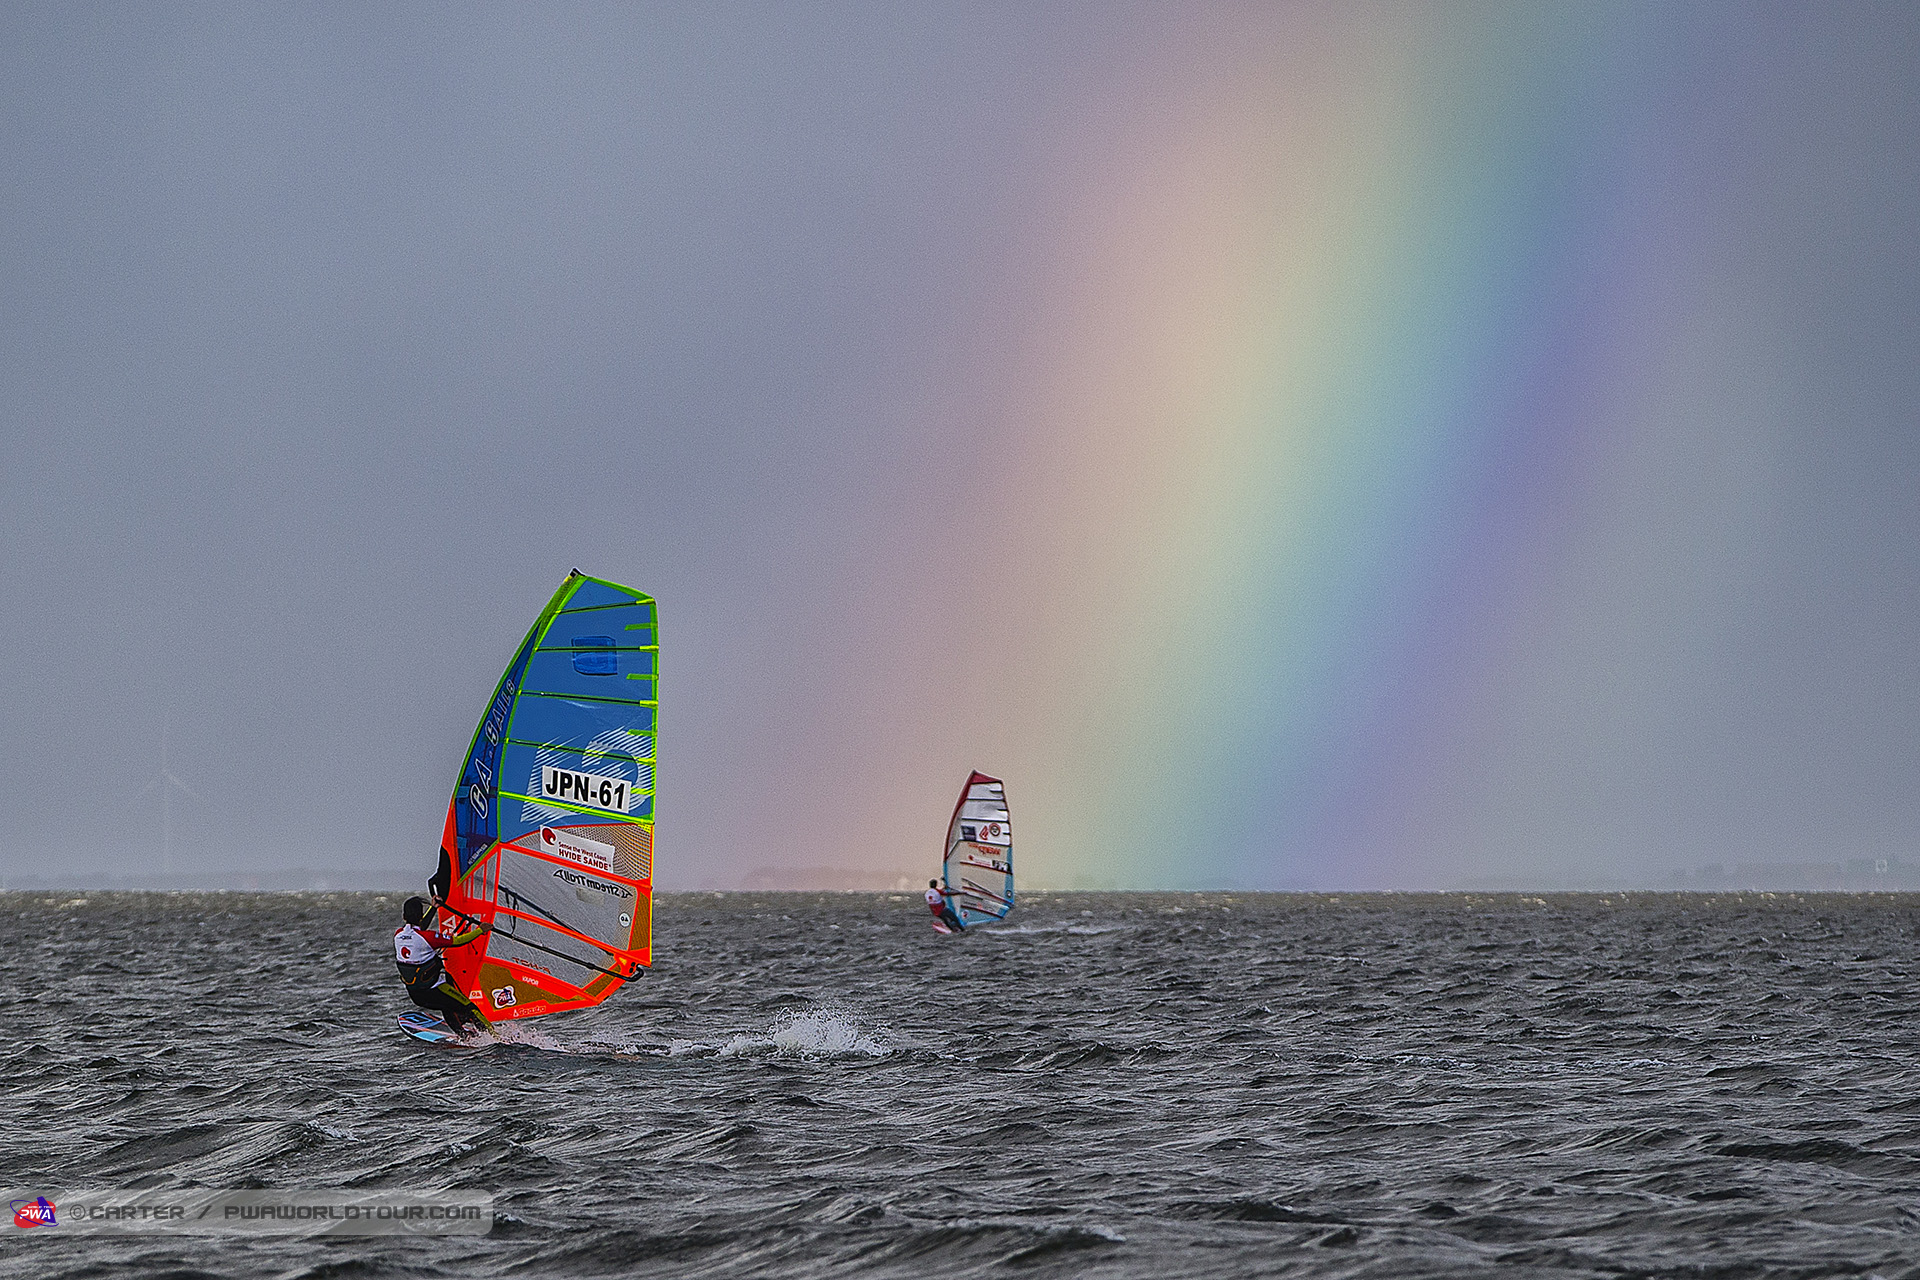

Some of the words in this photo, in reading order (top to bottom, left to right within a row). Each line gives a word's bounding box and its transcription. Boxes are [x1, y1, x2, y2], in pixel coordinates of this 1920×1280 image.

[545, 768, 627, 810] JPN-61
[558, 841, 573, 852] Sense
[581, 848, 594, 857] West
[593, 852, 607, 862] Coast
[558, 848, 582, 864] HVIDE
